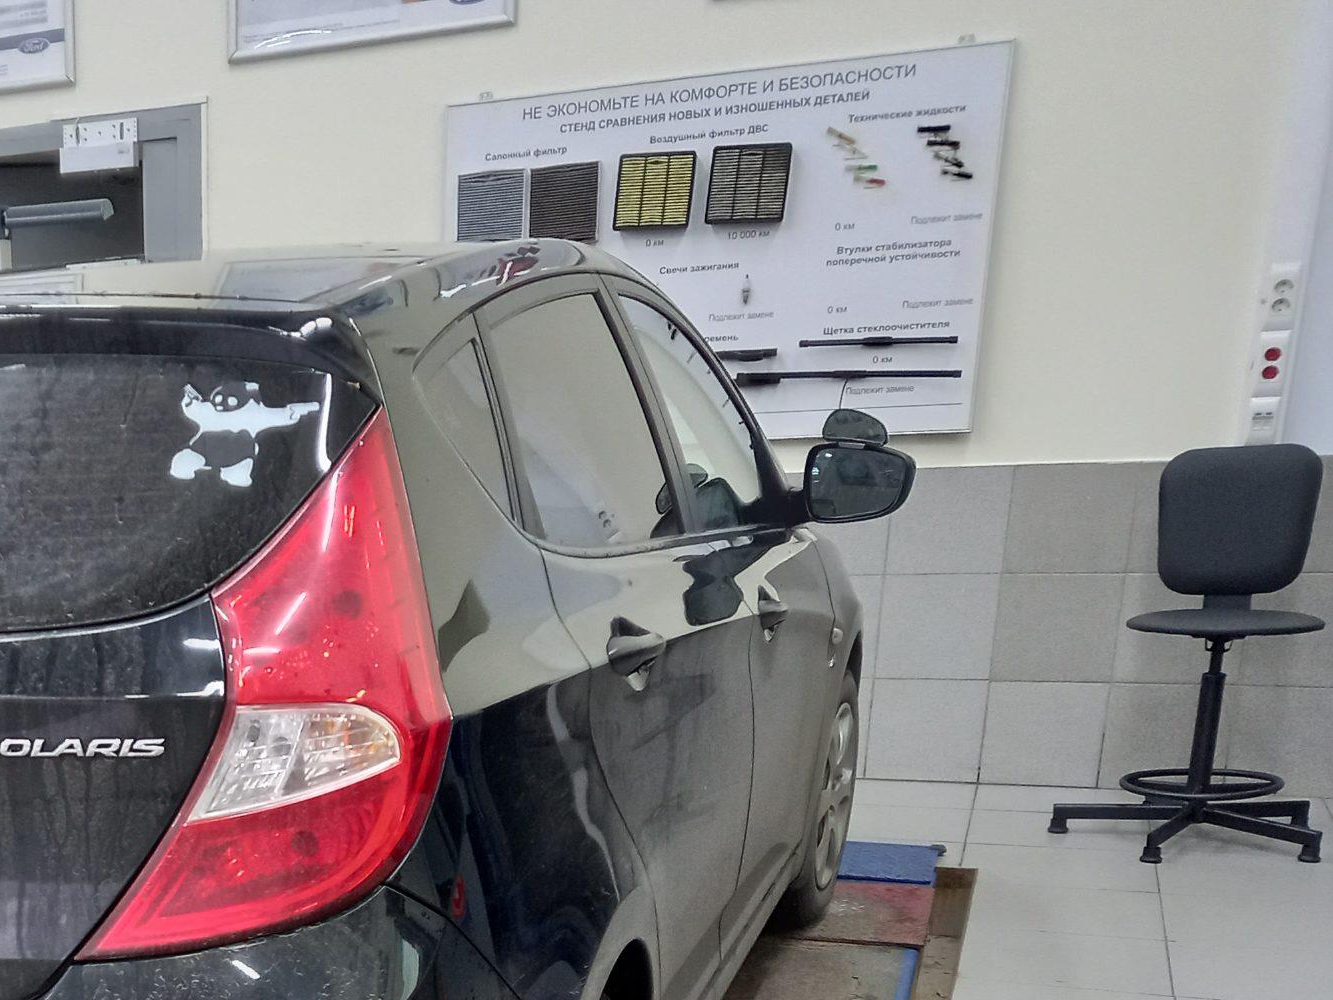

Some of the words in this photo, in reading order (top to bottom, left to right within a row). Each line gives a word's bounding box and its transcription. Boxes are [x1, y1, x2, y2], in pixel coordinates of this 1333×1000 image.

[522, 106, 543, 120] НЕ
[547, 95, 640, 118] ЭКОНОМЬТЕ
[644, 92, 666, 107] НА
[670, 81, 758, 104] КОМФОРТЕ
[762, 80, 774, 93] И
[778, 64, 917, 92] БЕЗОПАСНОСТИ
[559, 120, 596, 134] СТЕНД
[598, 113, 666, 129] СРАВНЕНИЯ
[668, 108, 711, 121] НОВЫХ
[713, 106, 723, 116] И
[725, 97, 811, 115] ИЗНОШЕННЫХ
[813, 90, 871, 107] ДЕТАЛЕЙ
[848, 109, 913, 124] Технические
[915, 104, 967, 117] жидкости
[648, 130, 706, 145] Воздушный
[708, 126, 746, 141] фильтр
[747, 124, 769, 135] ДВС
[485, 148, 531, 161] Салонный
[533, 145, 568, 159] фильтр
[843, 223, 855, 231] км
[728, 231, 737, 240] 10
[739, 230, 757, 240] 000
[758, 230, 770, 238] км
[653, 239, 665, 247] км
[836, 244, 873, 256] Втулки
[875, 239, 953, 253] стабилизатора
[825, 255, 887, 267] поперечной
[889, 249, 961, 265] устойчивости
[659, 266, 688, 276] Свечи
[690, 262, 740, 274] зажигания
[835, 306, 848, 314] км
[823, 325, 855, 336] Щетка
[856, 321, 951, 334] стеклоочистителя
[880, 356, 893, 364] км
